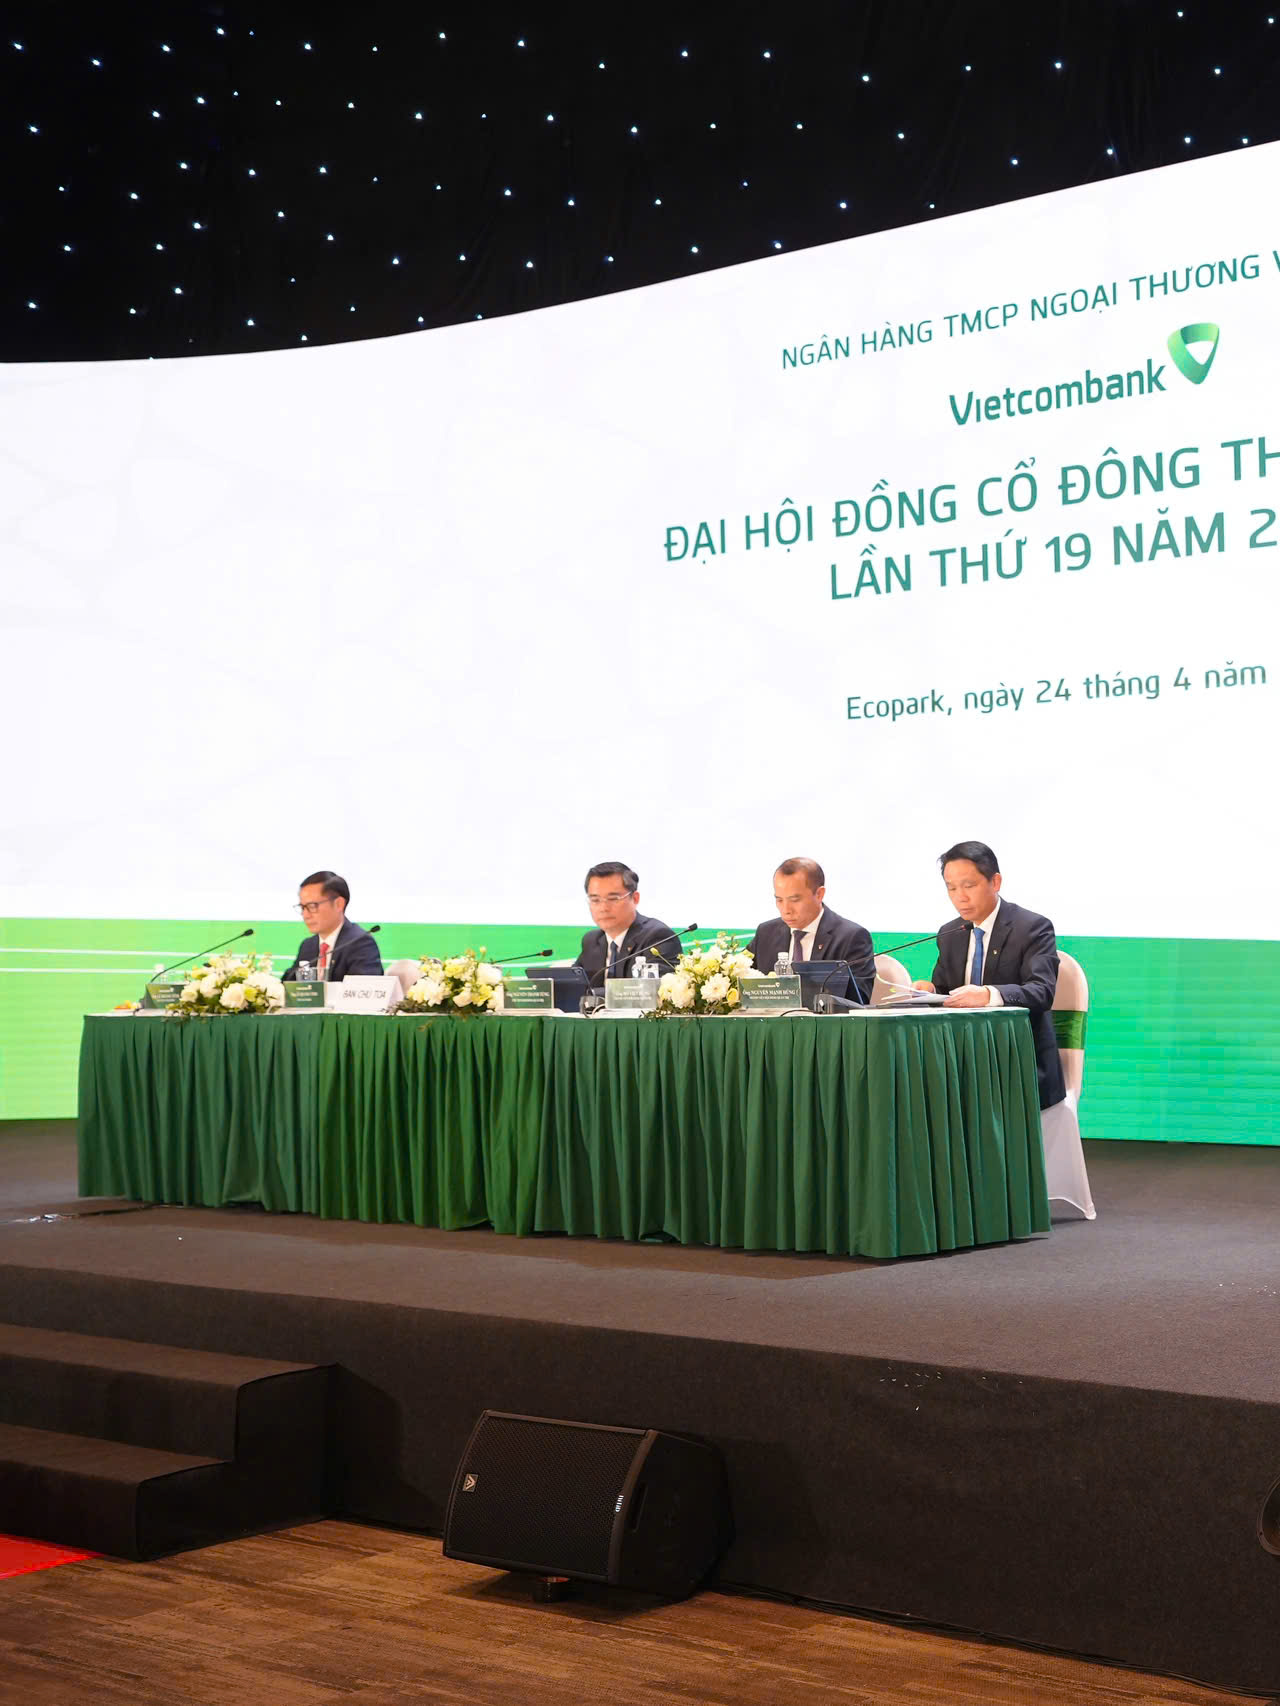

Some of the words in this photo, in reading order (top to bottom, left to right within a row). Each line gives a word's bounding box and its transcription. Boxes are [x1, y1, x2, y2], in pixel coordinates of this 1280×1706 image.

[783, 335, 850, 368] NGÂN
[862, 320, 932, 358] HÀNG
[944, 304, 1018, 336] TMCP
[1032, 282, 1117, 320] NGOẠI
[1129, 254, 1260, 301] THƯƠNG
[949, 358, 1167, 425] Vietcombank
[664, 520, 727, 565] ĐẠI
[745, 497, 814, 553] HỘI
[832, 480, 957, 537] ĐỒNG
[978, 457, 1037, 516] CỔ
[1058, 447, 1200, 507] ĐÔNG
[831, 544, 912, 600] LẦN
[929, 528, 1028, 588] THỨ
[1045, 533, 1092, 574] 19
[1113, 507, 1226, 566] NĂM
[847, 689, 953, 721] Ecopark,
[964, 682, 1025, 714] ngày
[1035, 678, 1072, 704] 24
[1083, 671, 1161, 701] tháng
[1174, 668, 1192, 691] 4
[1204, 660, 1267, 688] năm
